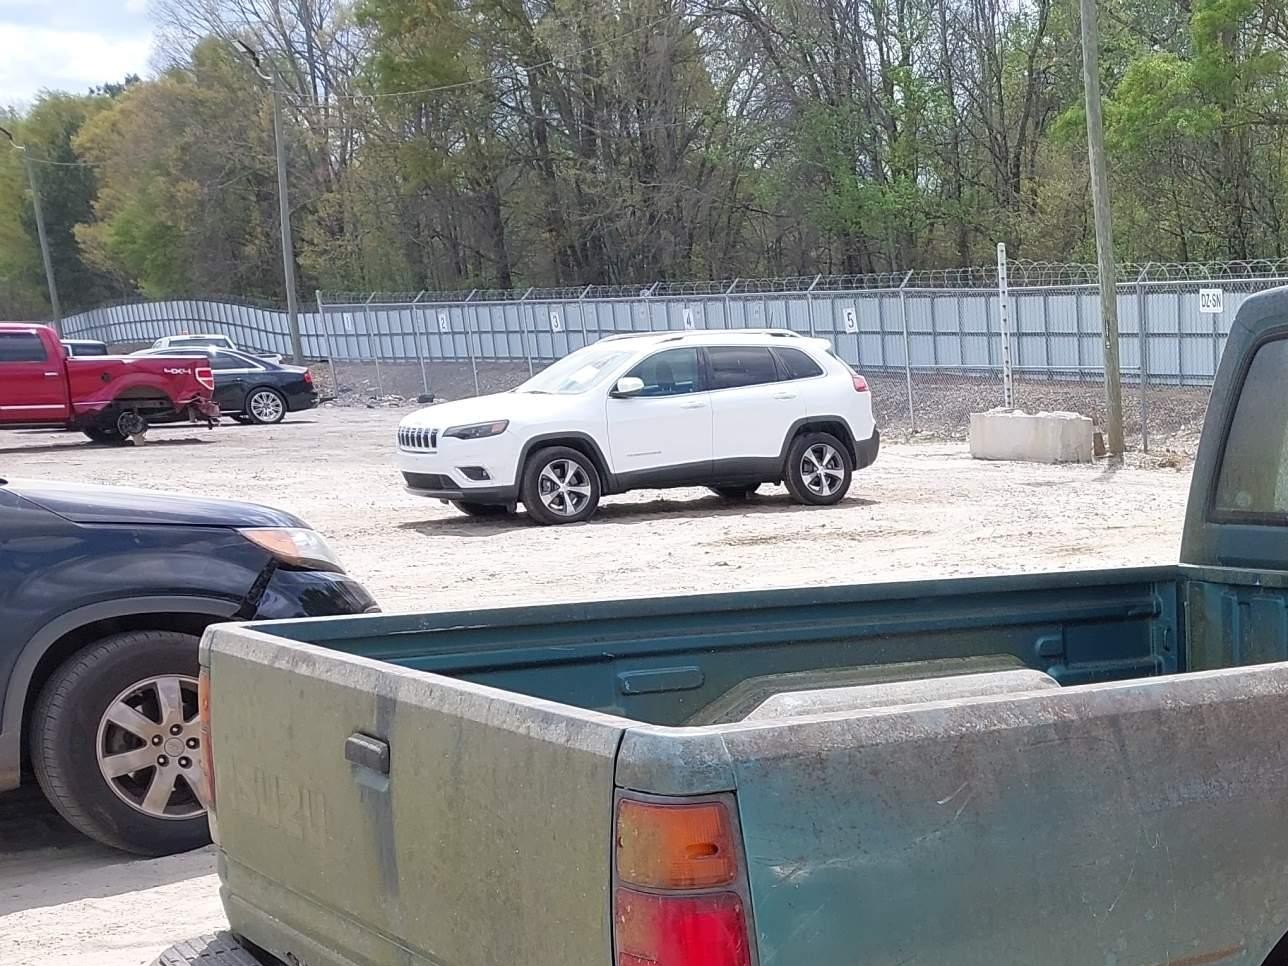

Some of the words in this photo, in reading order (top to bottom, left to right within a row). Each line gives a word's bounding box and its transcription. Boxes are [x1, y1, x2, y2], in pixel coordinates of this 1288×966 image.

[1201, 293, 1221, 308] DZ-SN
[552, 315, 559, 329] 3
[847, 312, 855, 329] 5
